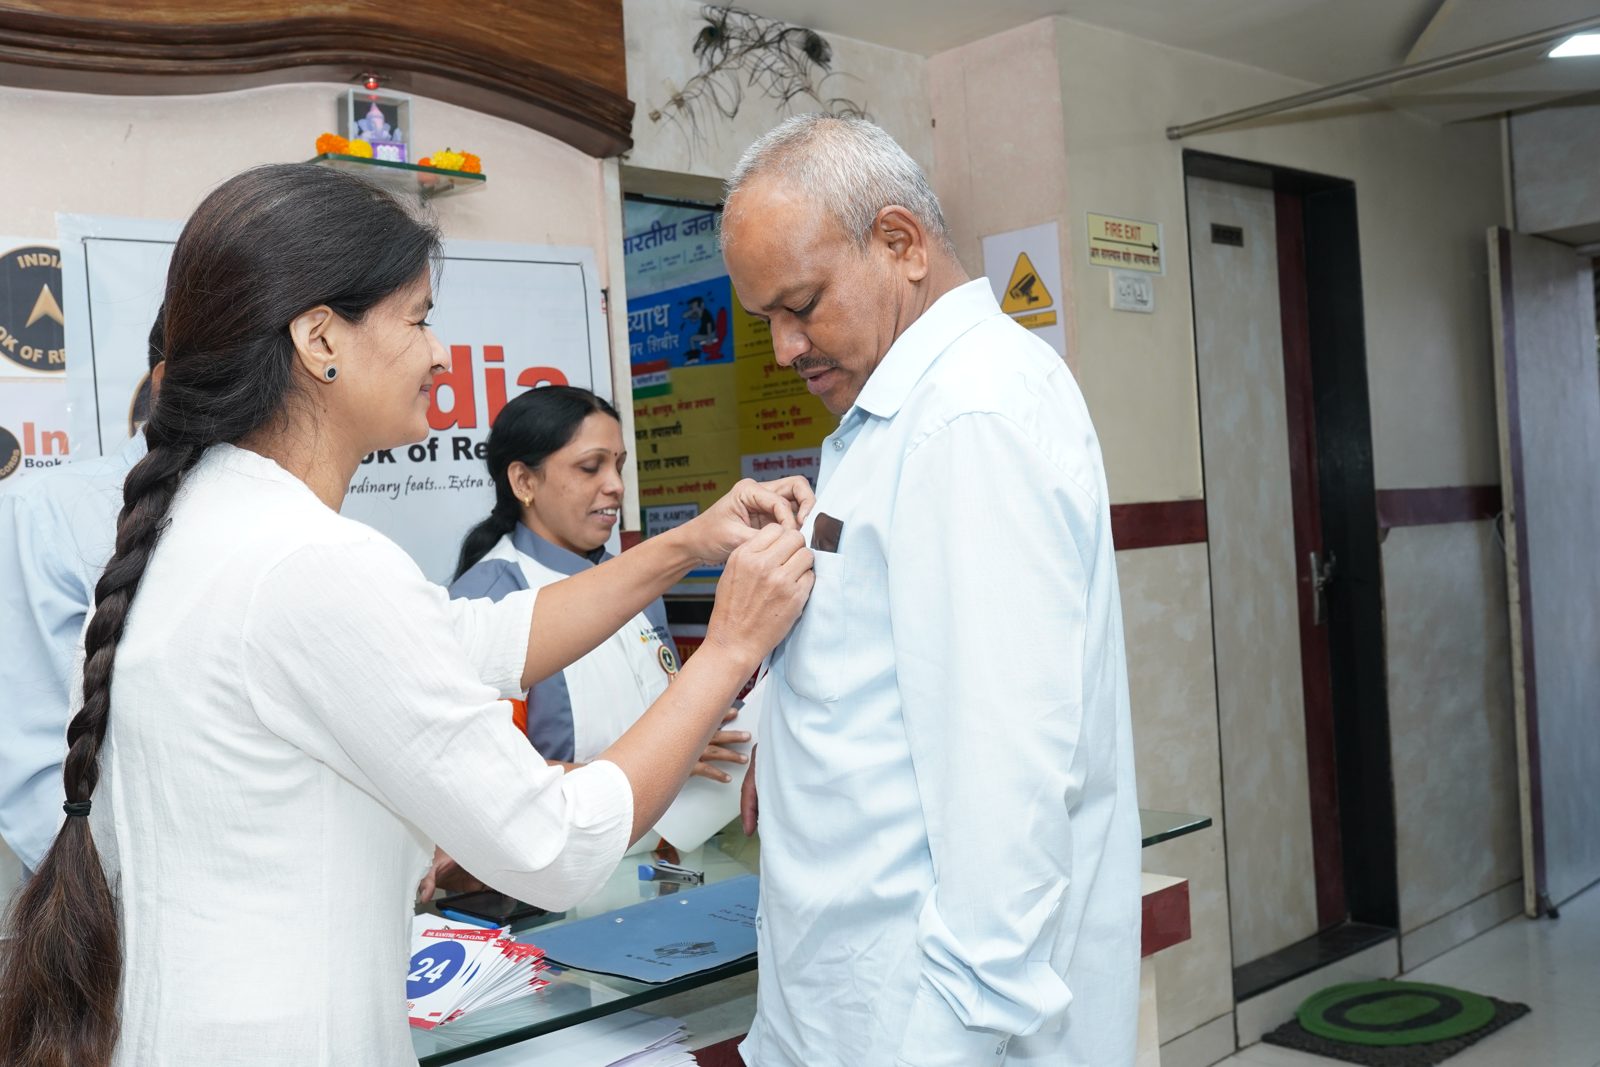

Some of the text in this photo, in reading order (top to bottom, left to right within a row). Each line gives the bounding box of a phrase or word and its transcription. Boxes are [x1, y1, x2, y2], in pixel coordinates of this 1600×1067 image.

[1104, 221, 1141, 241] FIRE EXIT
[20, 345, 44, 362] OF
[22, 422, 69, 456] In
[408, 437, 438, 463] of
[349, 477, 401, 500] rdinary
[406, 957, 452, 984] 24
